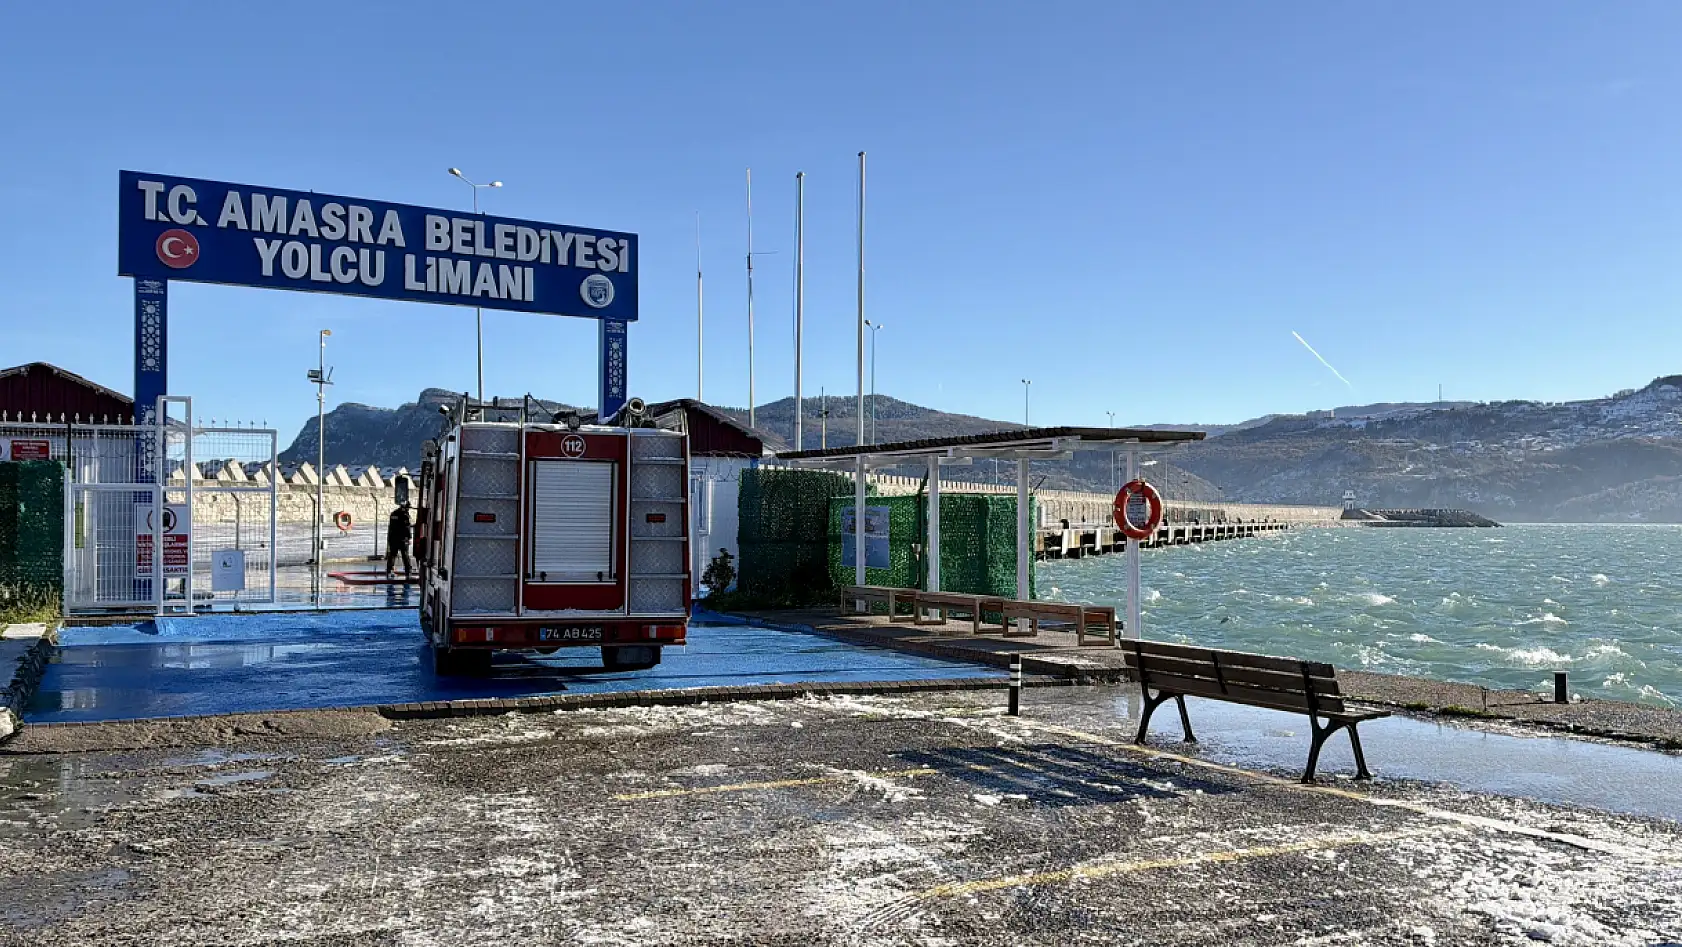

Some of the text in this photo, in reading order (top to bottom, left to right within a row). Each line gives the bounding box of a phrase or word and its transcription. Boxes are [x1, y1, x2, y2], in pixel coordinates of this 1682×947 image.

[138, 180, 208, 226] T.C.
[217, 190, 406, 248] AMASRA
[253, 237, 534, 301] YOLCU LİMANI
[564, 440, 582, 452] 112
[546, 628, 602, 639] 74 AB 425
